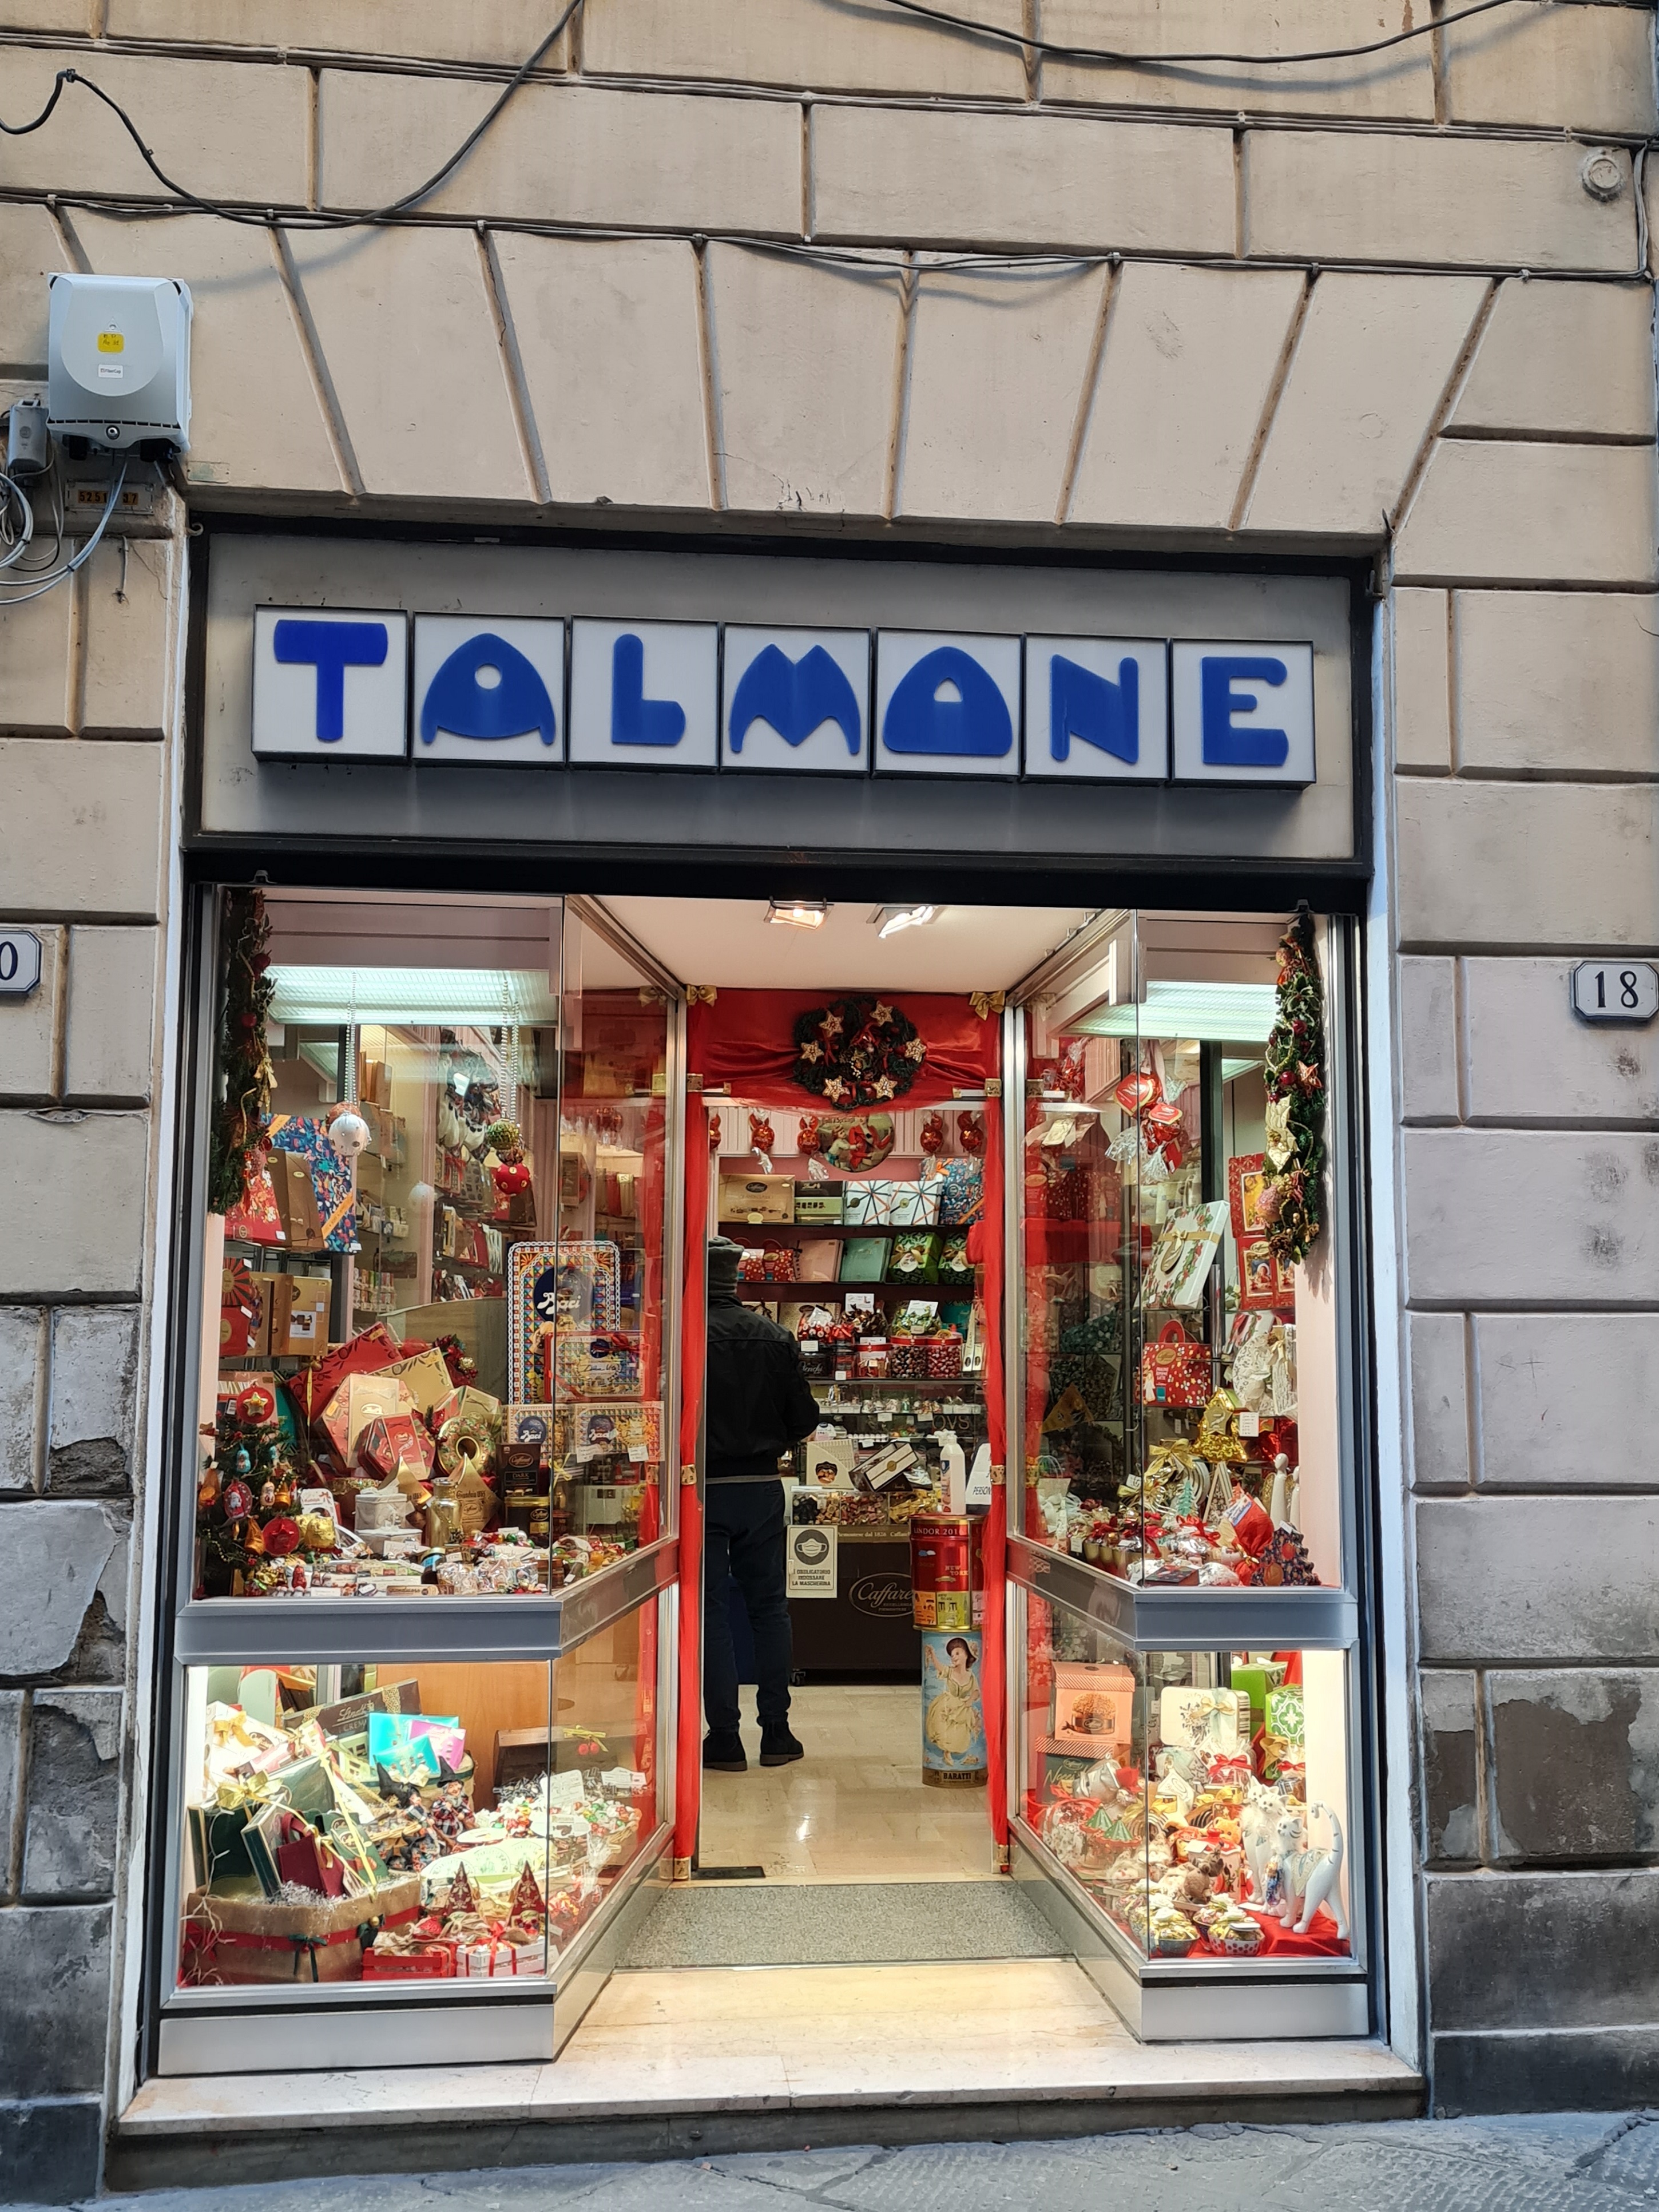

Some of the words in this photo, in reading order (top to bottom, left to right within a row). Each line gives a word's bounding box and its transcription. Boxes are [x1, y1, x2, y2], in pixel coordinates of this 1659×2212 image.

[0, 941, 18, 981] 0
[1594, 970, 1638, 1009] 18
[537, 1291, 581, 1315] Baci
[520, 1430, 542, 1442] Baci
[858, 1582, 913, 1608] Caffare
